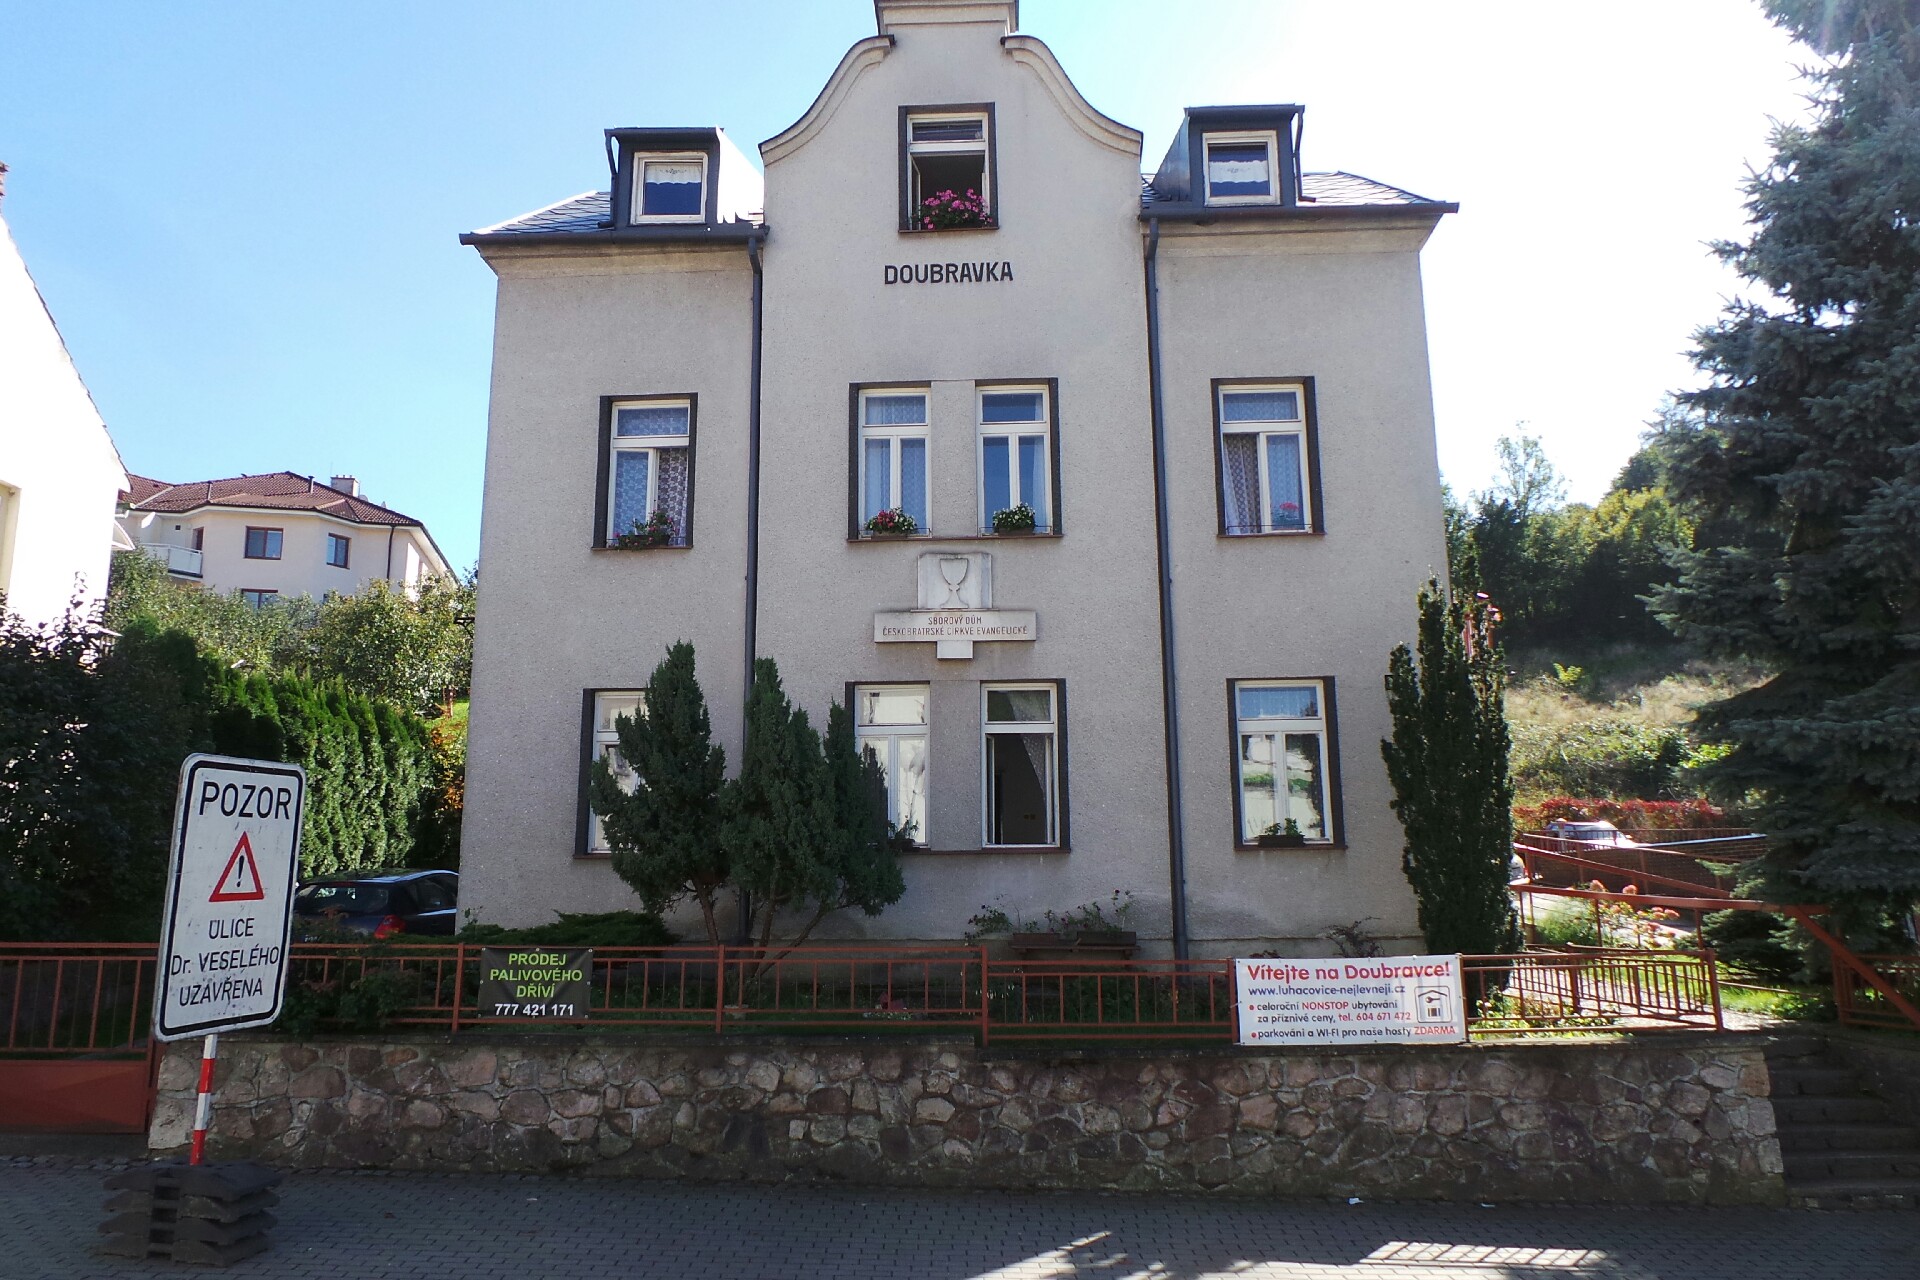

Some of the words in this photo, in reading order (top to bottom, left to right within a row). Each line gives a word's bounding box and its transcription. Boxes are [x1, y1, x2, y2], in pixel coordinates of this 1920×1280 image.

[884, 261, 1014, 285] DOUBRAVKA
[928, 615, 963, 625] SBOROVÝ
[965, 614, 982, 624] DŮM
[882, 626, 945, 636] ČESKOBRATRSKÉ
[199, 781, 292, 820] POZOR
[209, 918, 255, 939] ULICE
[171, 954, 191, 976] Dr.
[199, 944, 279, 972] VESELÉHO
[508, 953, 567, 966] PRODEJ
[489, 967, 583, 981] PALIVOVÉHO
[1247, 964, 1310, 984] Vítejte
[1315, 968, 1339, 980] na
[1344, 961, 1450, 979] Doubravce!
[179, 977, 263, 1006] UZAVŘENA
[516, 983, 555, 998] DŘÍVÍ
[1248, 983, 1405, 996] www.luhacovice-nejlevneji.cz
[494, 1003, 519, 1016] 777
[522, 1003, 546, 1016] 421
[551, 1003, 574, 1016] 171
[1256, 1001, 1300, 1011] celoroční
[1301, 1001, 1349, 1010] NONSTOP
[1271, 1013, 1309, 1024] příznivé
[1311, 1014, 1336, 1023] ceny,
[1338, 1012, 1354, 1021] tel.
[1356, 1012, 1374, 1021] 604
[1376, 1012, 1391, 1021] 671
[1394, 1011, 1411, 1021] 472
[1316, 1028, 1339, 1037] WI-FI
[1341, 1029, 1358, 1038] pro
[1360, 1027, 1383, 1036] naše
[1385, 1026, 1411, 1037] hosty
[1414, 1025, 1456, 1035] ZDARMA
